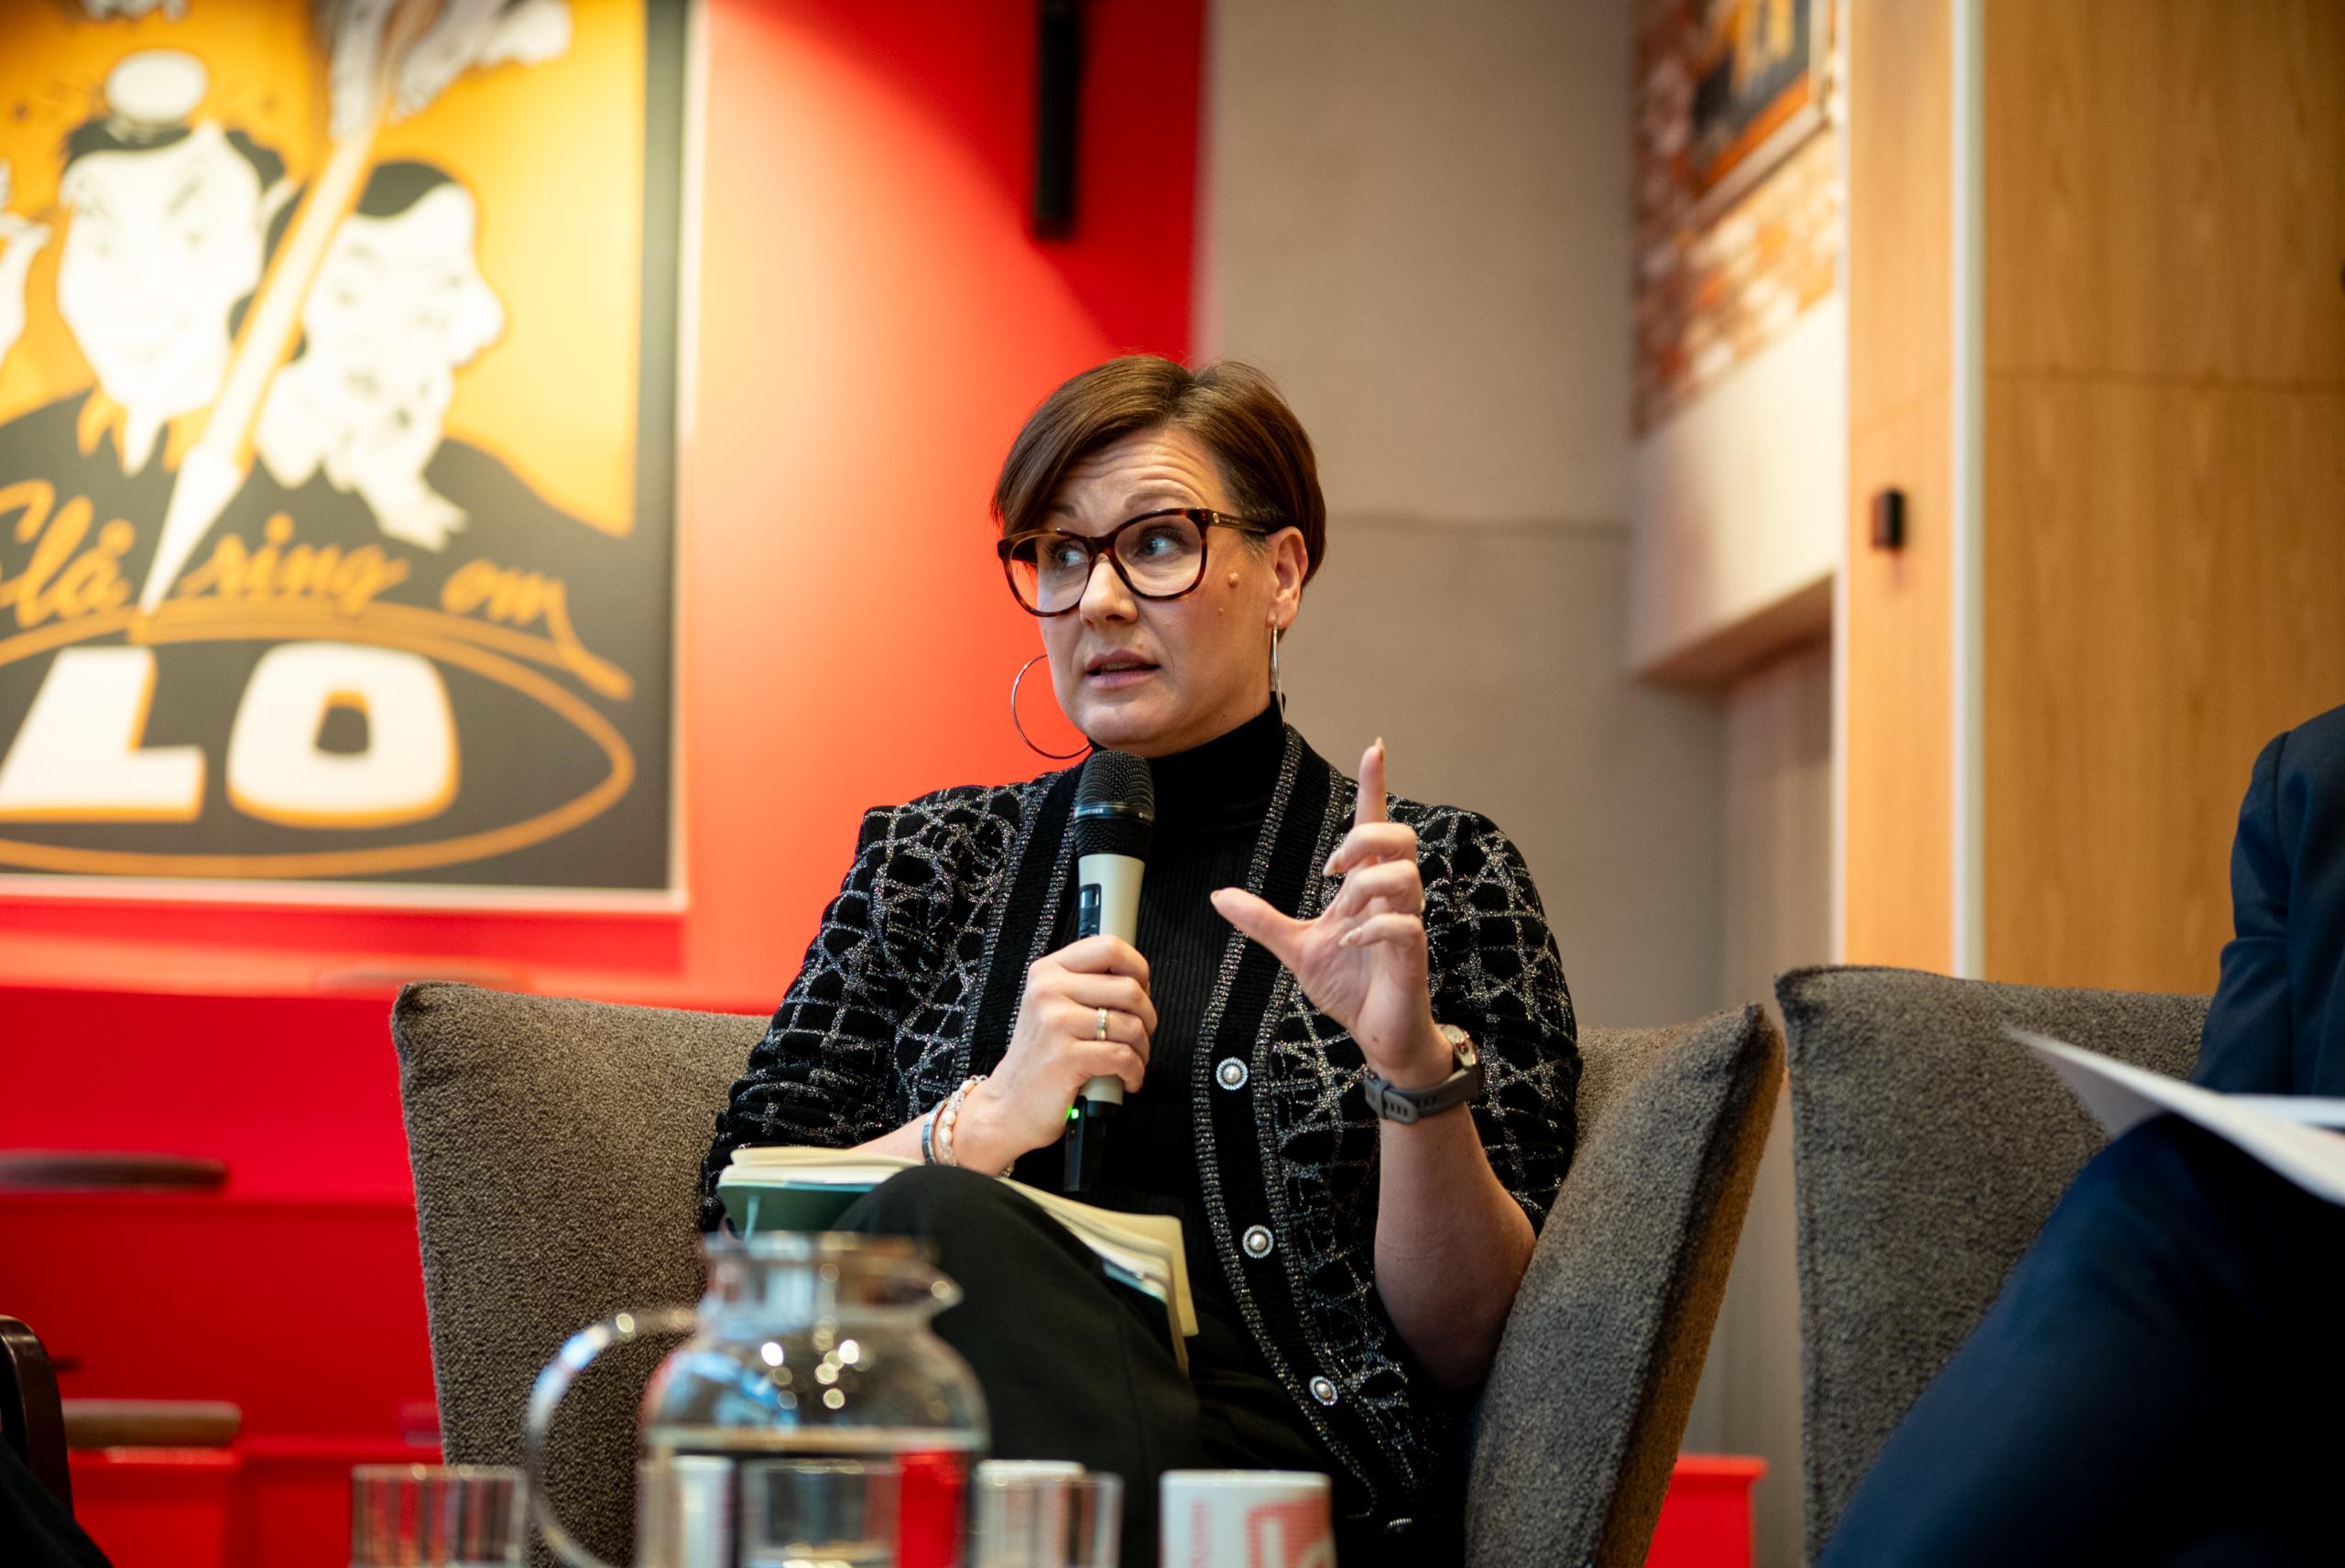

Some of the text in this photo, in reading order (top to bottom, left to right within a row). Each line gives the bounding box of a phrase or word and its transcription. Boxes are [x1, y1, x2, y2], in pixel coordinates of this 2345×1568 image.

[179, 511, 410, 617] ring
[441, 558, 636, 702] om
[0, 641, 460, 830] LO
